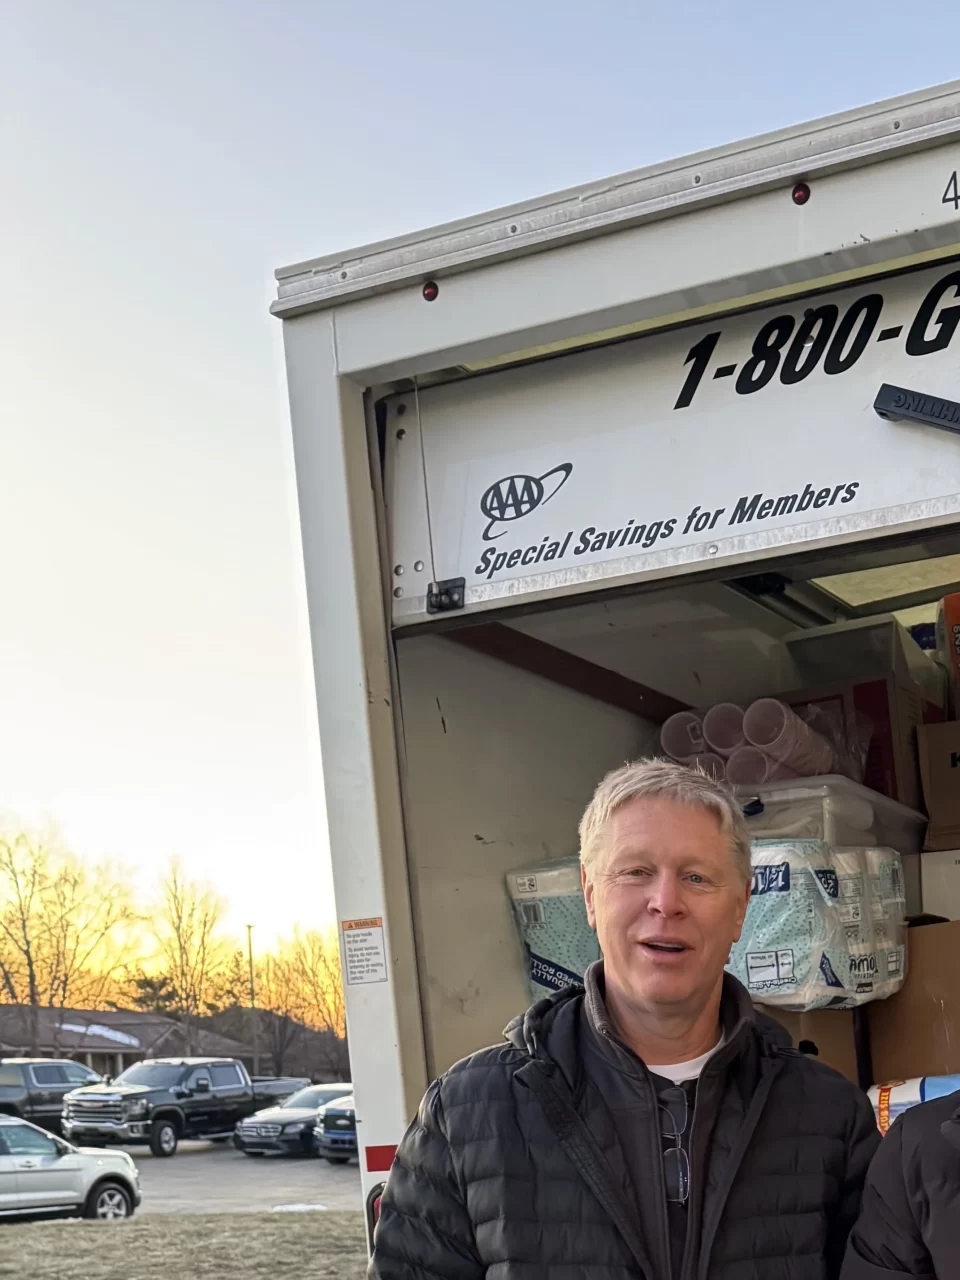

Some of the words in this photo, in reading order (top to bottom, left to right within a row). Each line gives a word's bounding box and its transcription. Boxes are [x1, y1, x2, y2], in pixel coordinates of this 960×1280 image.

[488, 478, 538, 519] AAA
[475, 532, 573, 580] Special
[573, 516, 678, 556] Savings
[682, 505, 726, 535] for
[727, 481, 860, 527] Members
[531, 960, 556, 974] ROLL
